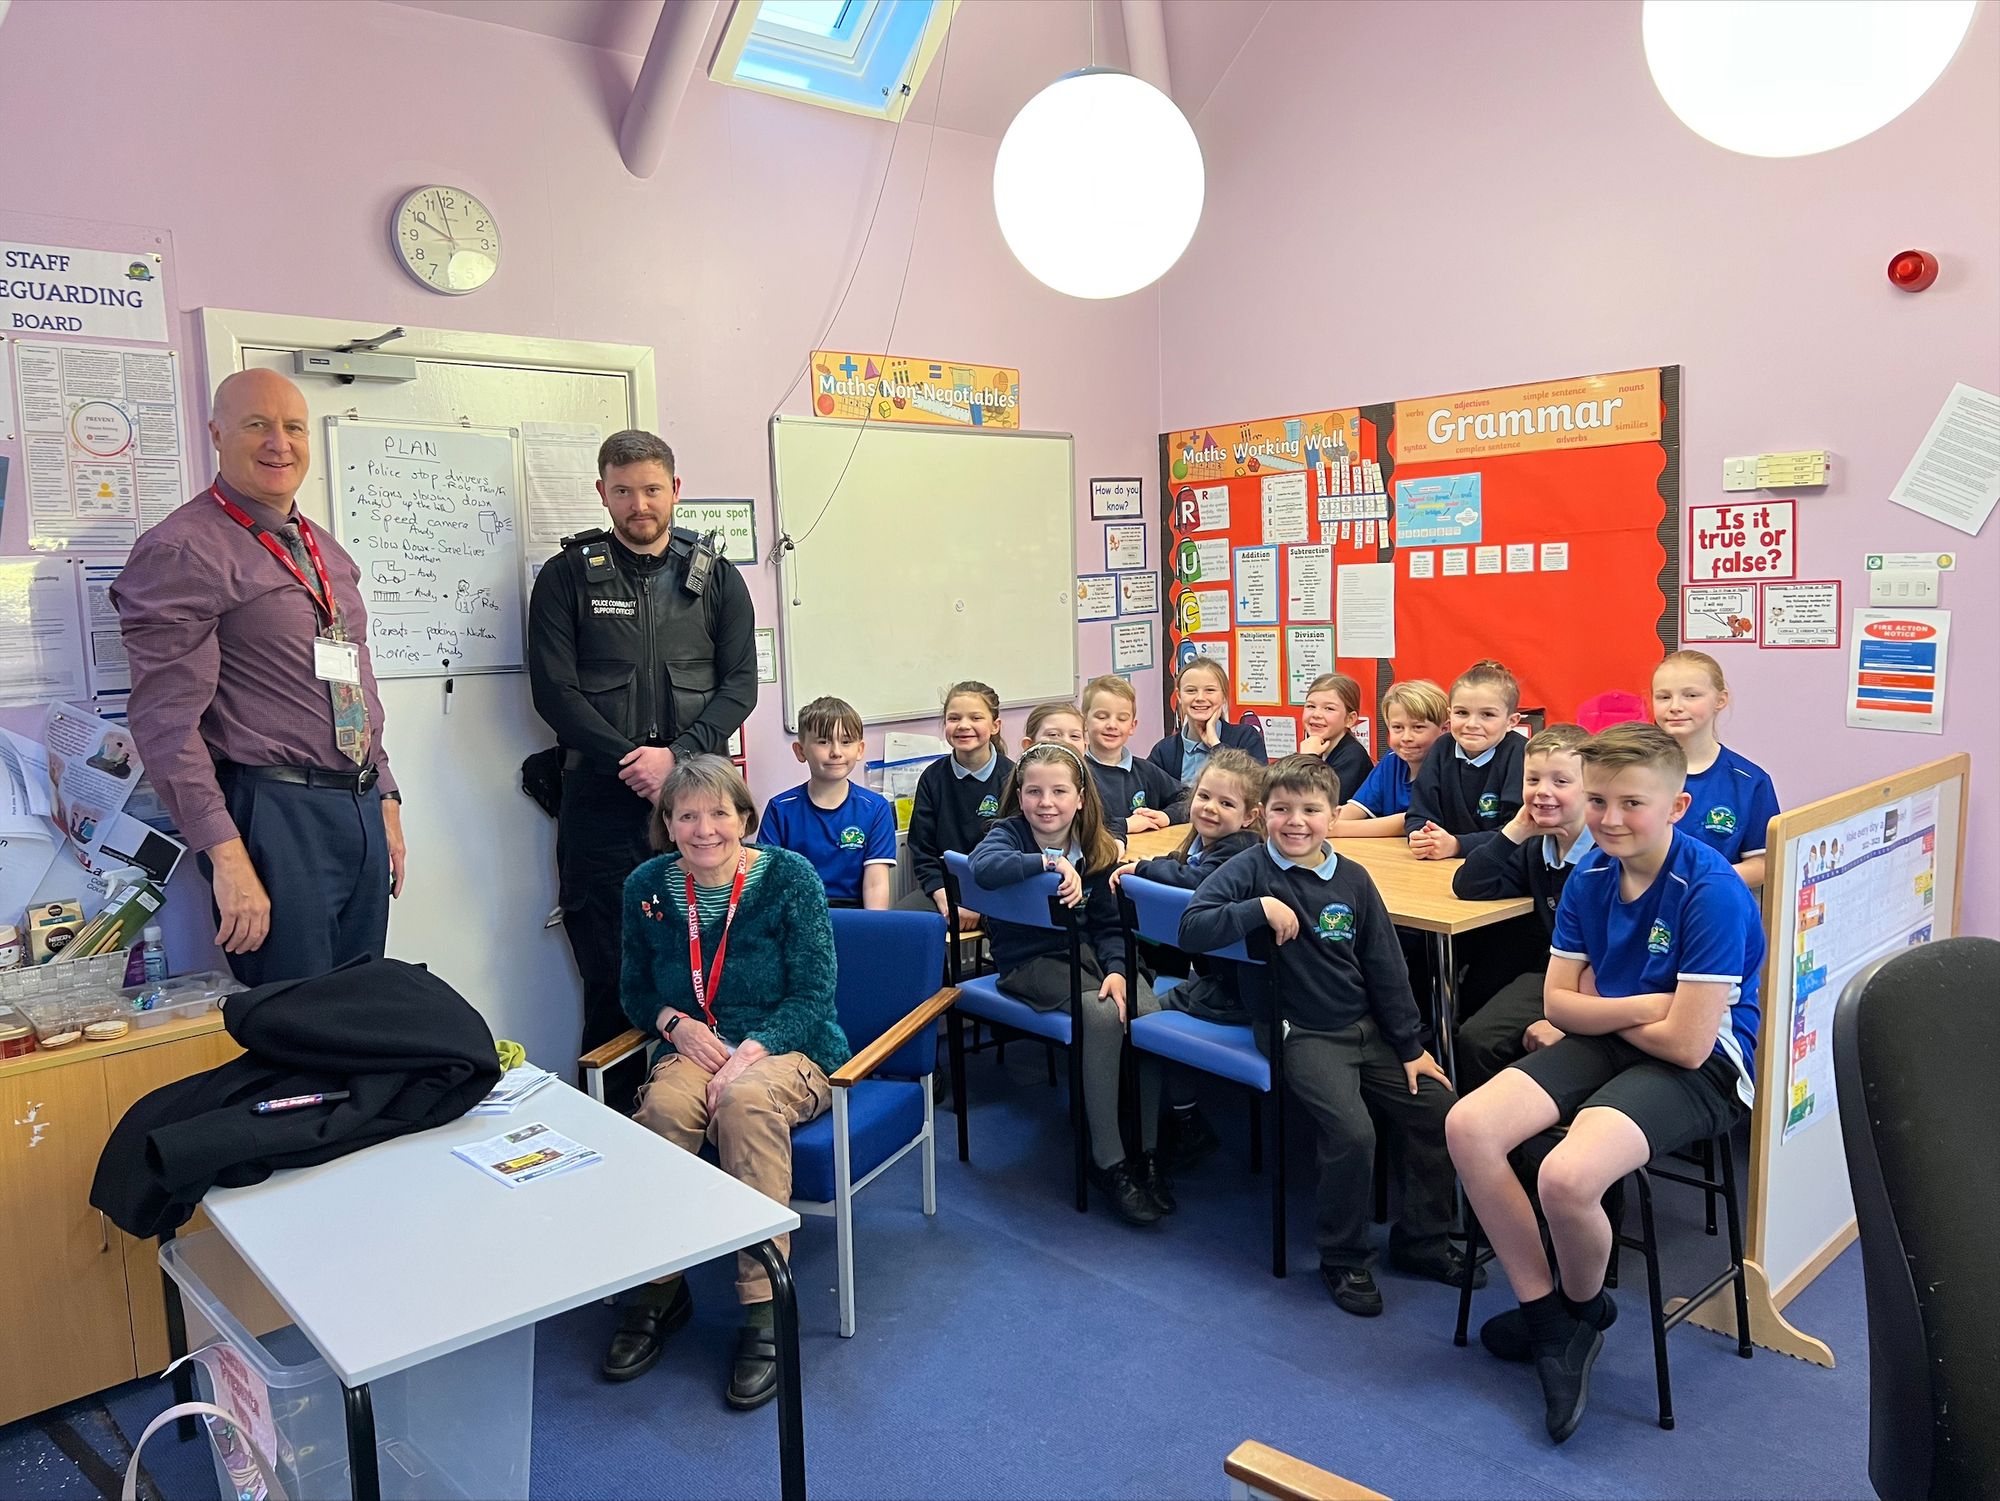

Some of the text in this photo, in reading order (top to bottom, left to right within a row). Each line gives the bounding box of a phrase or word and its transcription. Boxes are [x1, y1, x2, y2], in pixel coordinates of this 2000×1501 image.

[426, 199, 435, 211] 11
[442, 197, 455, 209] 12
[464, 205, 468, 216] 1
[412, 211, 426, 223] 10
[476, 220, 485, 232] 2
[409, 229, 419, 241] 9
[481, 239, 489, 250] 3
[6, 251, 70, 272] STAFF
[416, 248, 425, 260] 8
[429, 263, 438, 275] 7
[12, 313, 82, 332] BOARD
[819, 375, 1017, 408] Maths Non-Negotiables
[1522, 383, 1645, 401] simple sentence nouns
[1405, 400, 1490, 418] verbs adjectives
[1427, 397, 1623, 444] Grammar
[1403, 420, 1648, 454] syntax complex sentence adverbs similies
[384, 436, 437, 457] PLAN
[1182, 429, 1344, 465] Maths Working Wall
[368, 460, 489, 489] Police stop drivers
[367, 484, 402, 508] Signs
[462, 493, 492, 507] down
[1095, 484, 1140, 497] How do you
[676, 507, 749, 521] Can you spot
[1106, 501, 1129, 511] know?
[1182, 501, 1196, 524] R
[371, 509, 469, 532] Speed camera
[1716, 507, 1770, 531] Is it
[730, 528, 748, 536] one
[1699, 527, 1786, 550] true or
[368, 536, 398, 549] Slow
[1290, 547, 1329, 555] Subtraction
[1181, 551, 1198, 575] U
[1242, 551, 1270, 559] Addition
[1712, 549, 1782, 578] false?
[1183, 602, 1197, 624] C
[372, 618, 408, 638] Parents
[375, 645, 420, 662] Lorries
[688, 903, 700, 941] VISITOR
[693, 968, 705, 1007] VISITOR
